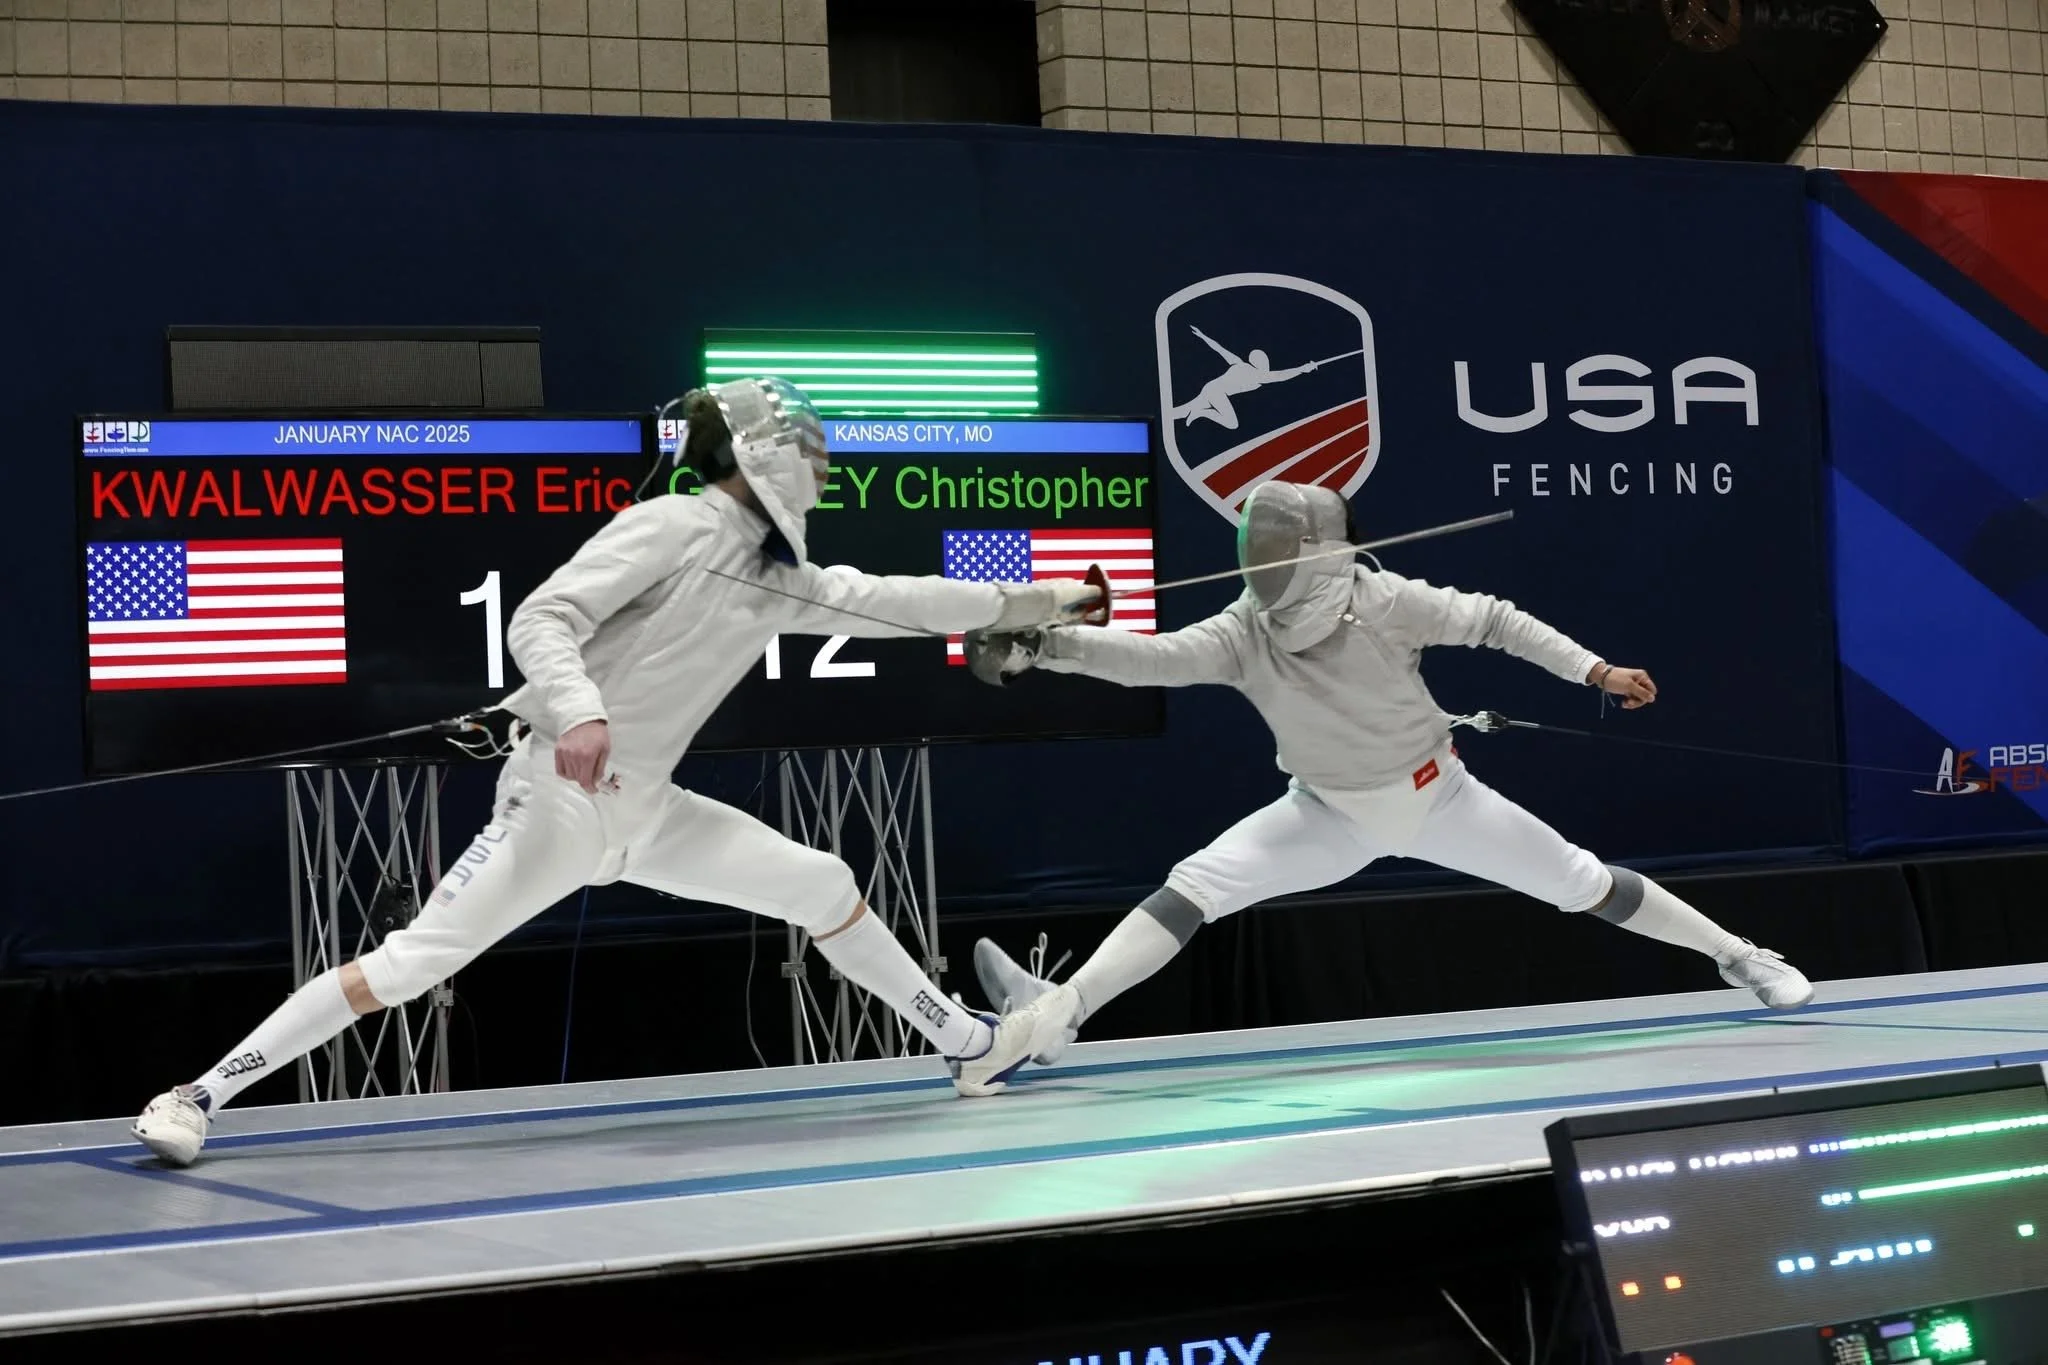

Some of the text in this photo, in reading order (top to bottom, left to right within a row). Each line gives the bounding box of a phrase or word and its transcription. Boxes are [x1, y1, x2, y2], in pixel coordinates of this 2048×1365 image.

[1454, 354, 1760, 433] USA
[274, 424, 470, 444] JANUARY NAC 2025
[835, 424, 993, 445] KANSAS CITY, MO
[92, 467, 632, 518] KWALWASSER Eric
[895, 467, 1149, 519] Christopher
[1493, 462, 1733, 497] FENCING
[1990, 744, 2048, 767] ABS
